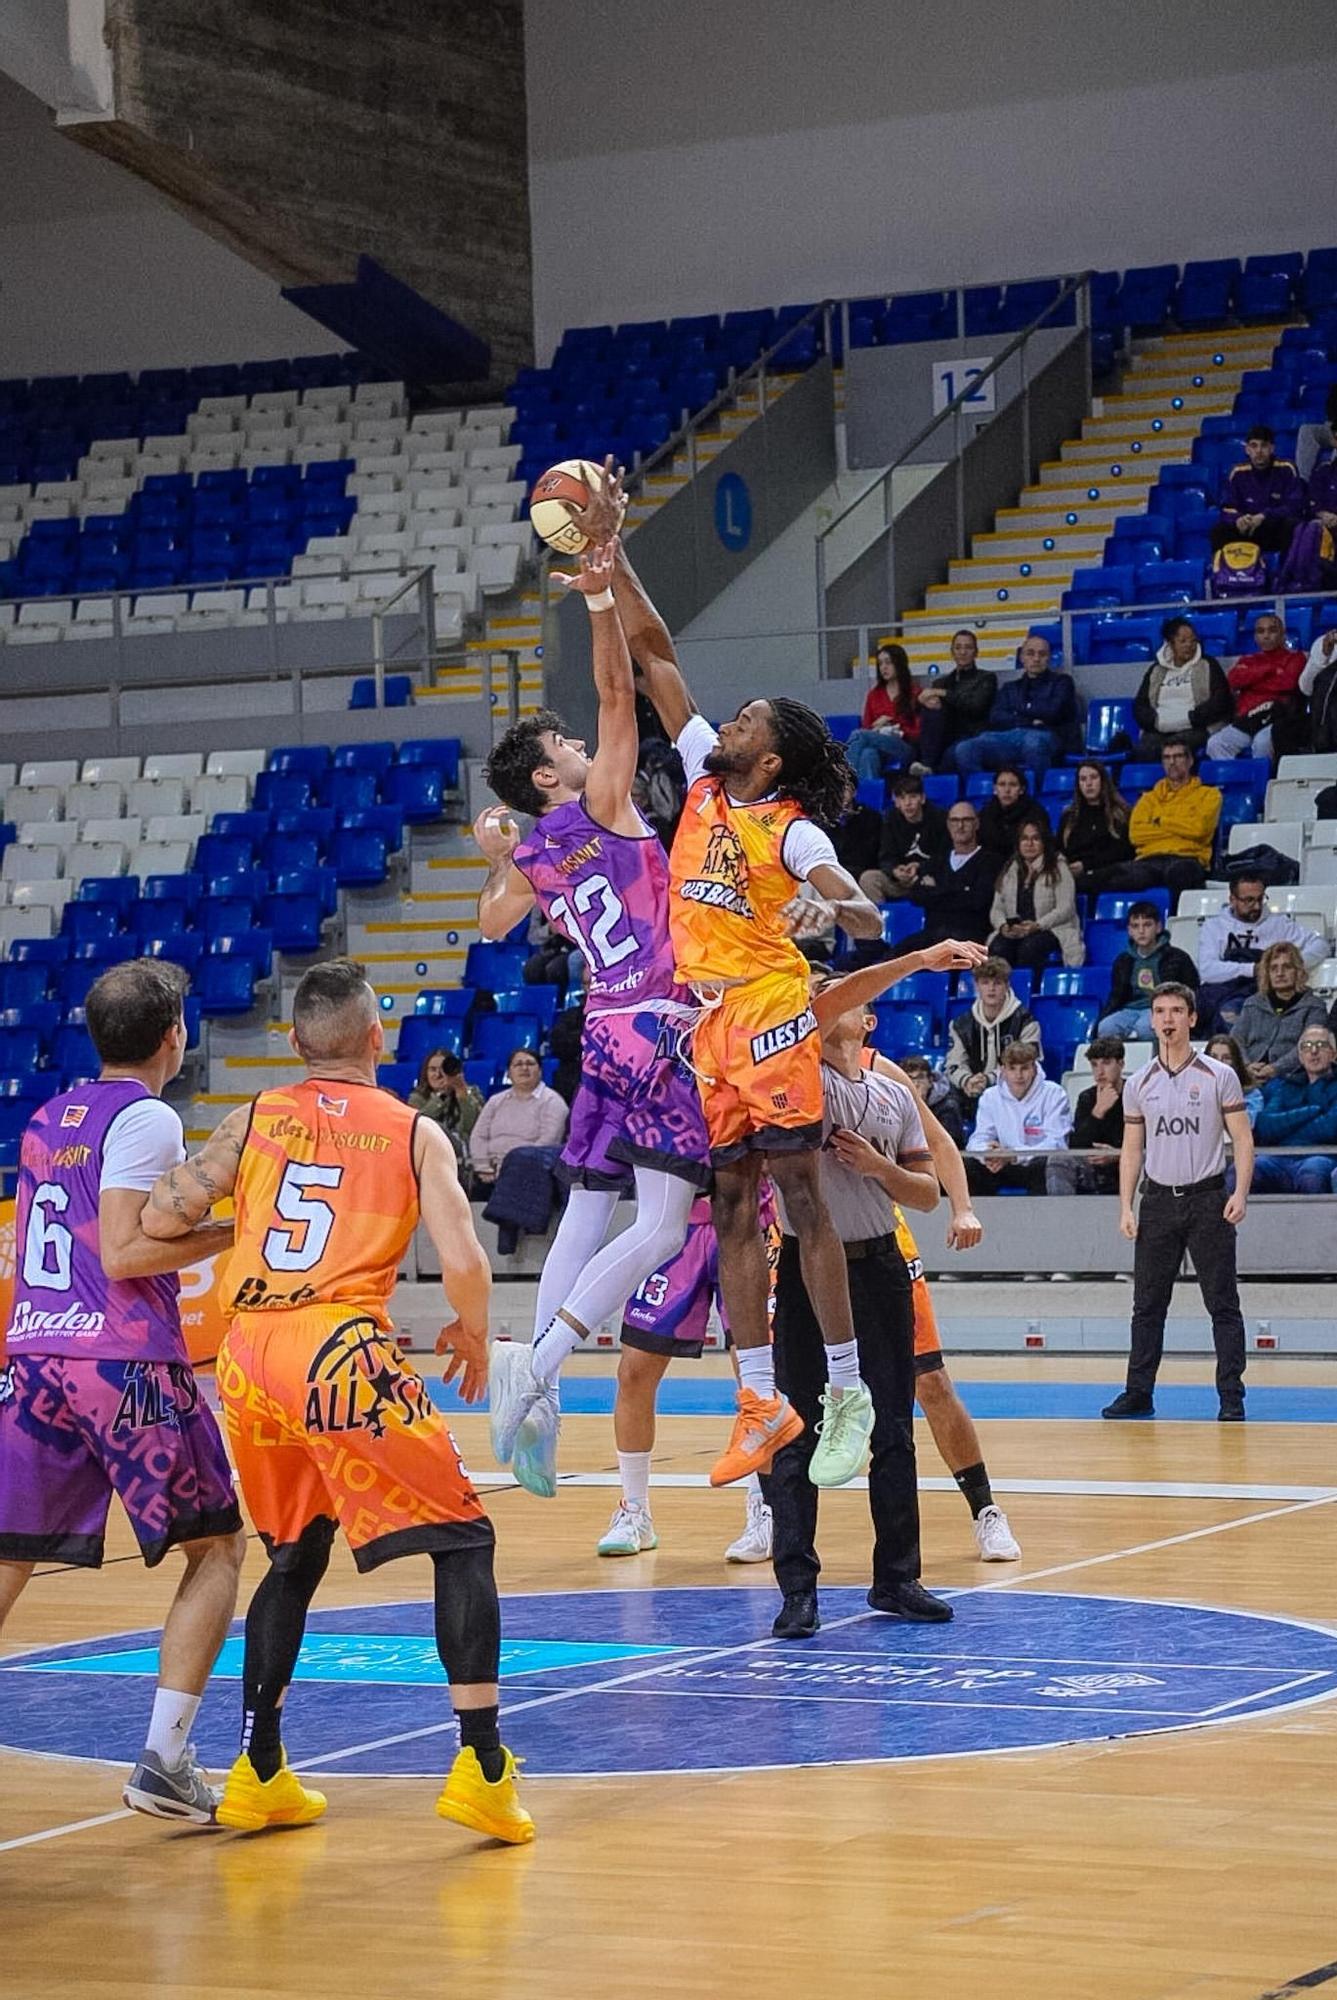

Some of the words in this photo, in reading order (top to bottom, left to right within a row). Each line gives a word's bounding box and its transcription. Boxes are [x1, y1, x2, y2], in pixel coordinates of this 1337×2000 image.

[941, 368, 987, 405] 12
[726, 489, 743, 537] L
[550, 874, 640, 974] 12
[752, 1021, 796, 1063] ILLES
[1155, 1115, 1200, 1137] AON
[261, 1159, 345, 1273] 5
[22, 1181, 73, 1291] 6
[636, 1273, 669, 1306] 13
[6, 1300, 106, 1336] Baden
[304, 1379, 363, 1434] ALL
[659, 1667, 1008, 1690] Ajuntament
[747, 1659, 943, 1677] Palma
[954, 1668, 1037, 1679] de
